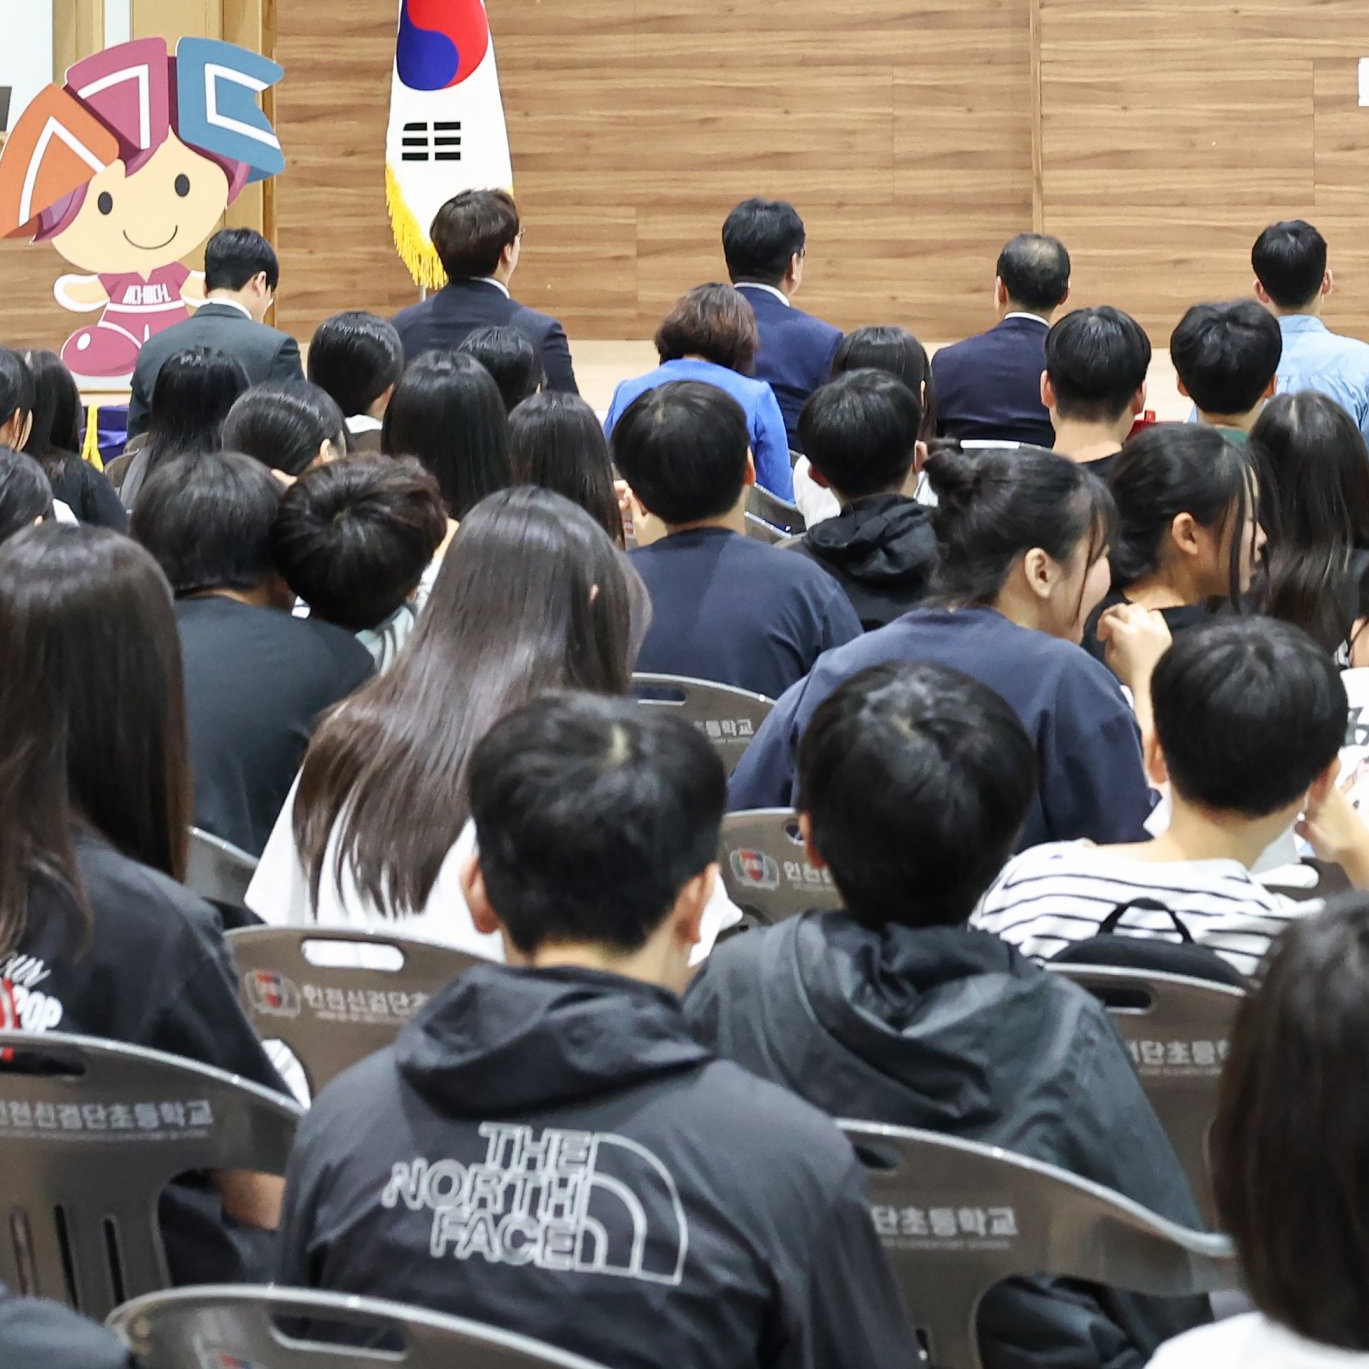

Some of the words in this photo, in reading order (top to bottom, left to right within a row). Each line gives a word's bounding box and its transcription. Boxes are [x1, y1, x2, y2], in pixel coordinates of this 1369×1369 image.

[478, 1121, 591, 1170] THE
[381, 1157, 590, 1231] NORTH
[429, 1205, 577, 1271] FACE
